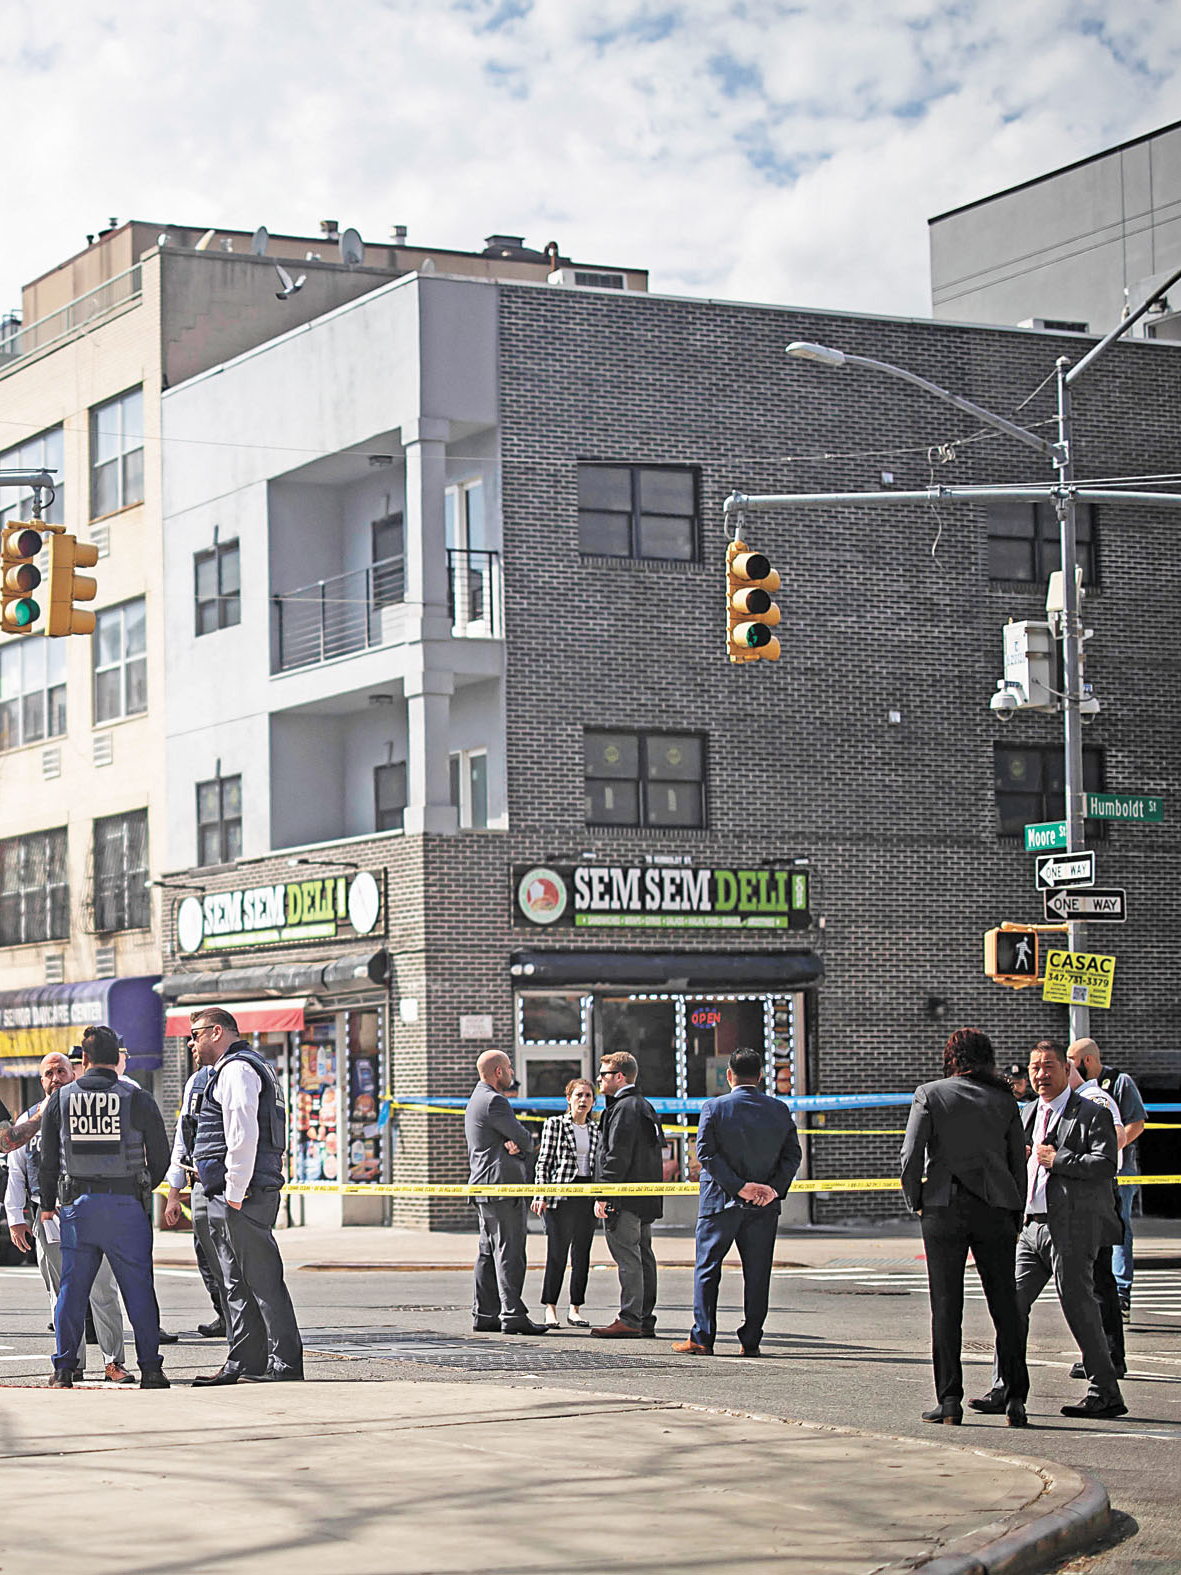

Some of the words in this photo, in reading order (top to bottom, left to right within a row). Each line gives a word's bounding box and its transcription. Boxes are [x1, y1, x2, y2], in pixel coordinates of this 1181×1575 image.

[1091, 797, 1144, 818] Humboldt
[1149, 800, 1157, 812] St
[1027, 828, 1055, 847] Moore
[1059, 825, 1067, 838] St
[1046, 866, 1061, 878] ONE
[1071, 864, 1087, 876] WAY
[575, 868, 641, 910] SEM
[645, 868, 711, 911] SEM
[715, 870, 788, 912] DELI
[204, 890, 242, 935] SEM
[243, 884, 286, 930] SEM
[287, 878, 335, 924] DELI
[1054, 898, 1079, 910] ONE
[1093, 898, 1117, 910] WAY
[1050, 953, 1112, 973] CASAC
[1048, 973, 1109, 987] 347-731-3379
[32, 1004, 69, 1025] DAYCARE
[691, 1011, 721, 1024] OPEN
[70, 1092, 120, 1116] NYPD
[70, 1116, 121, 1134] POLICE
